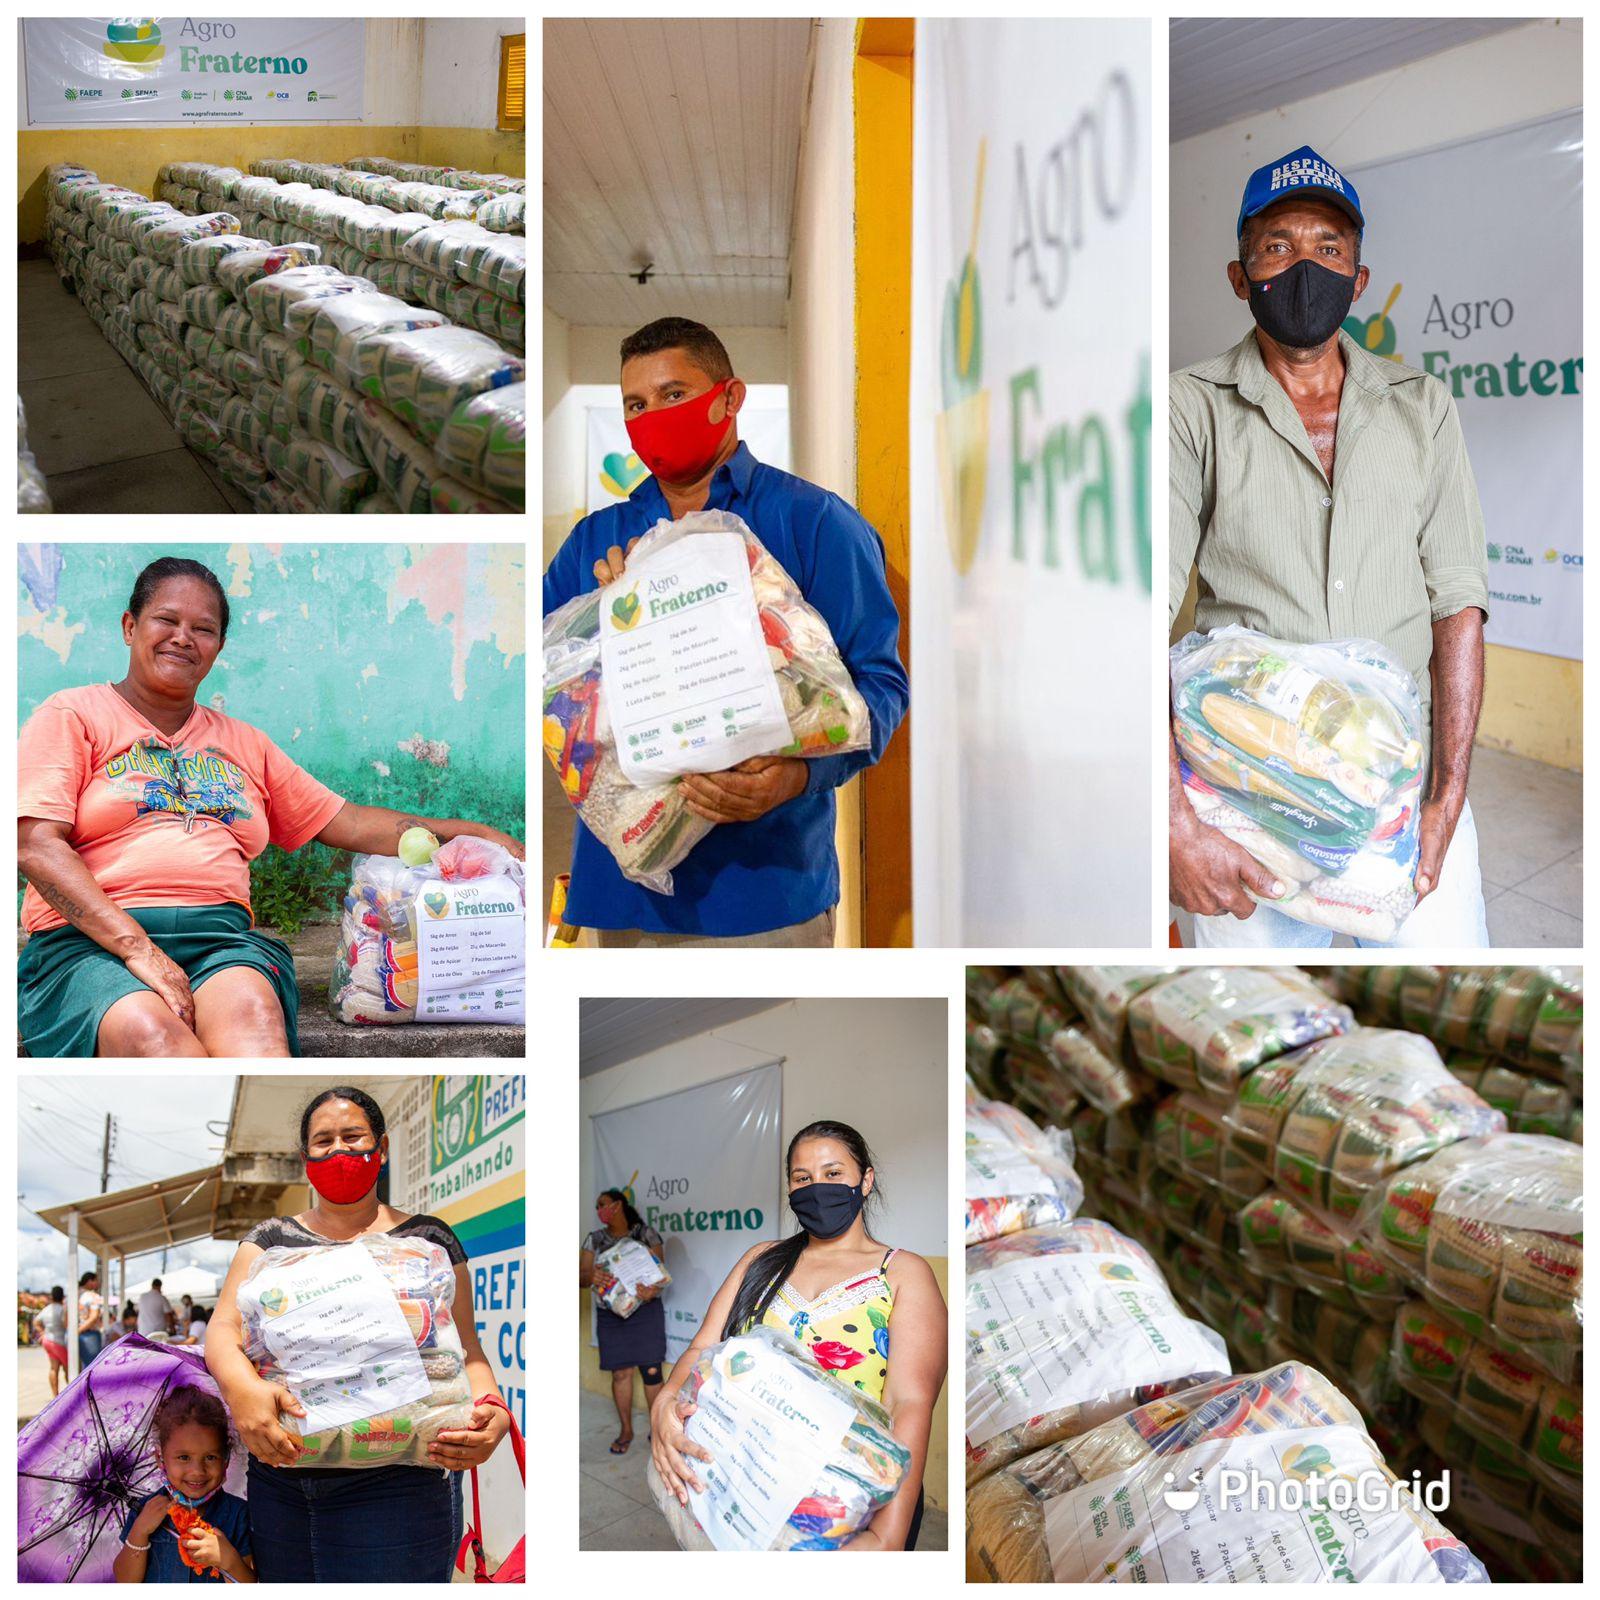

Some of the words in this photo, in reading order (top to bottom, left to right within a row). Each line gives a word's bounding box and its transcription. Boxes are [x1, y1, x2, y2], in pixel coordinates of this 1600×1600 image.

[179, 17, 237, 42] Agro
[179, 45, 309, 75] Fraterno
[80, 89, 103, 97] FAEPE
[1005, 66, 1139, 312] Agro
[1421, 293, 1514, 339] Agro
[648, 574, 679, 595] Agro
[650, 581, 728, 618] Fraterno
[455, 901, 515, 916] Fraterno
[484, 1075, 525, 1126] PREF
[430, 1141, 513, 1203] Trabalhando
[646, 1175, 690, 1200] Agro
[646, 1206, 764, 1232] Fraterno
[294, 1274, 363, 1305] Fraterno
[474, 1260, 526, 1311] REF
[1118, 1290, 1172, 1354] Fraterno
[1199, 1482, 1208, 1494] de
[1100, 1510, 1110, 1528] CNA
[1121, 1502, 1136, 1530] FAEPE
[1202, 1494, 1218, 1522] Açúcar
[1092, 1514, 1104, 1538] SENAR
[1190, 1548, 1201, 1566] 2kg
[1196, 1567, 1206, 1580] de
[1244, 1536, 1256, 1552] 2kg
[1250, 1552, 1260, 1564] de
[1270, 1530, 1282, 1545] 1kg
[1277, 1545, 1287, 1558] de
[1282, 1558, 1295, 1572] Sal
[1220, 1550, 1238, 1584] Pacotes
